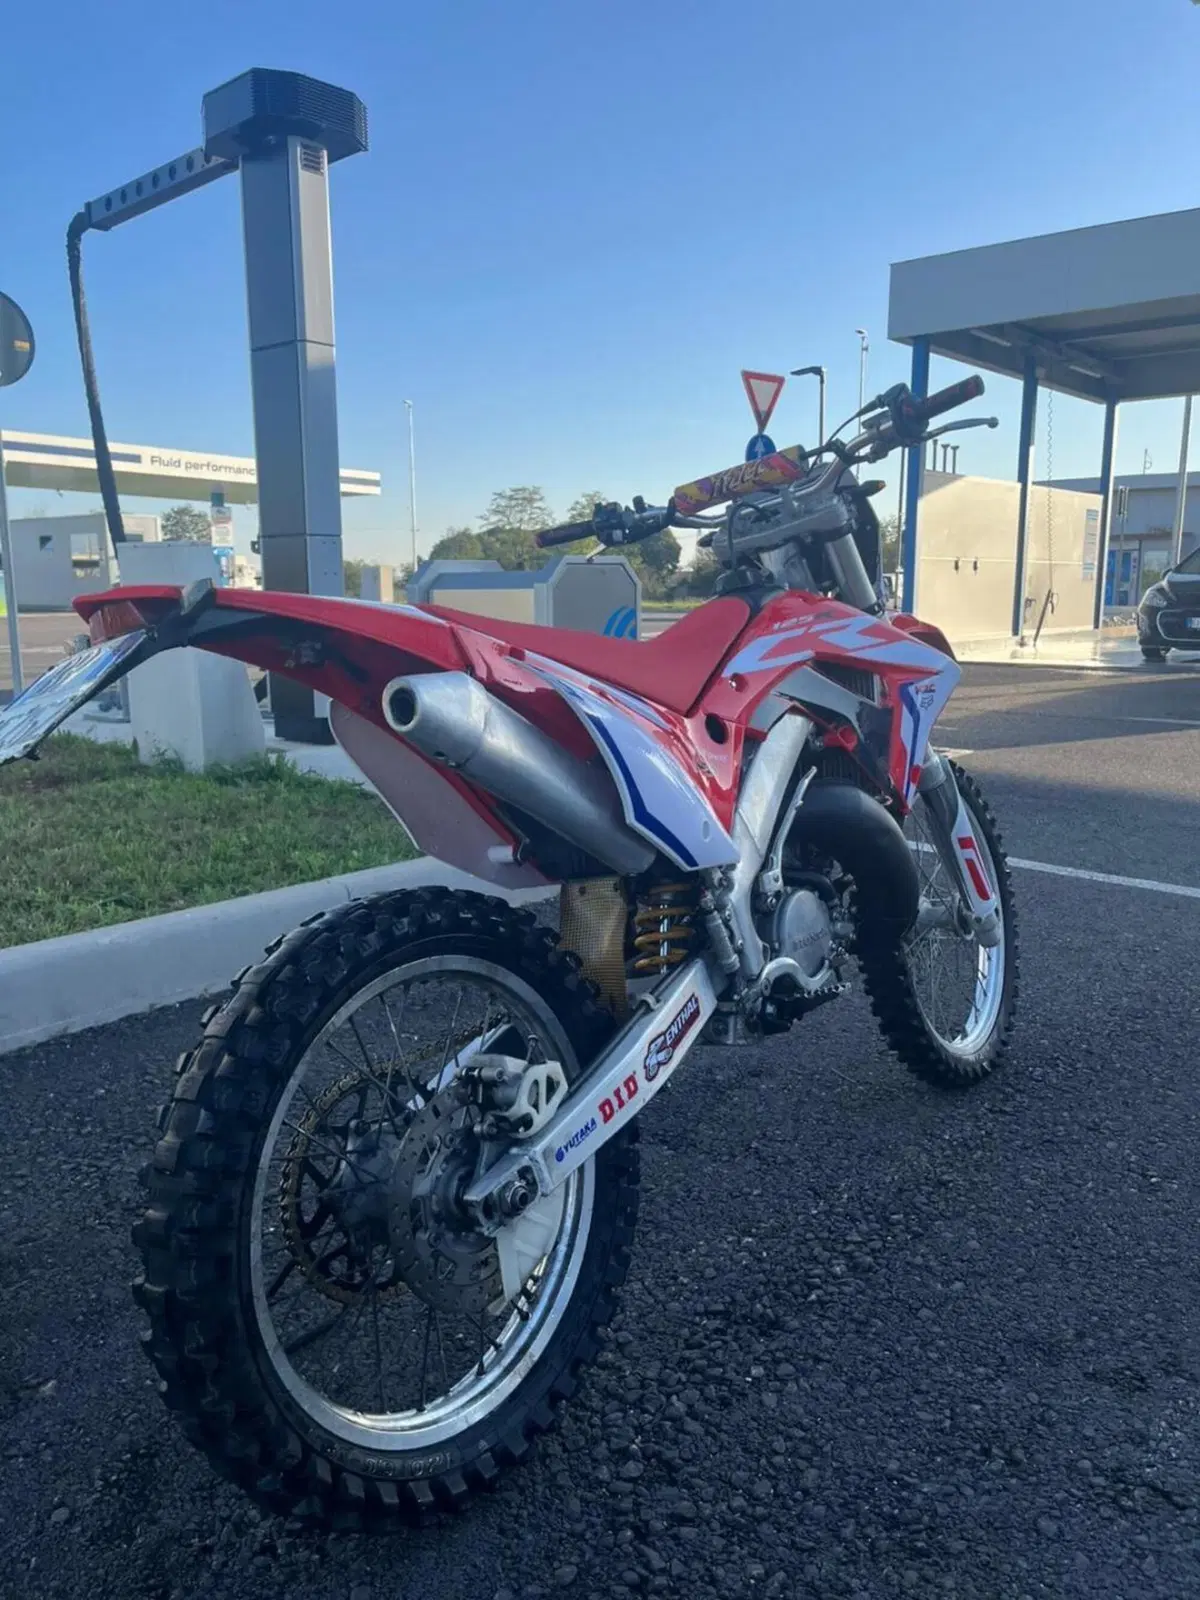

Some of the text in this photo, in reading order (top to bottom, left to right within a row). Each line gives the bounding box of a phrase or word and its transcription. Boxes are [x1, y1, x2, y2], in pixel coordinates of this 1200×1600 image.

[150, 455, 256, 477] Fluid performanc
[562, 1116, 598, 1153] YUTAKA
